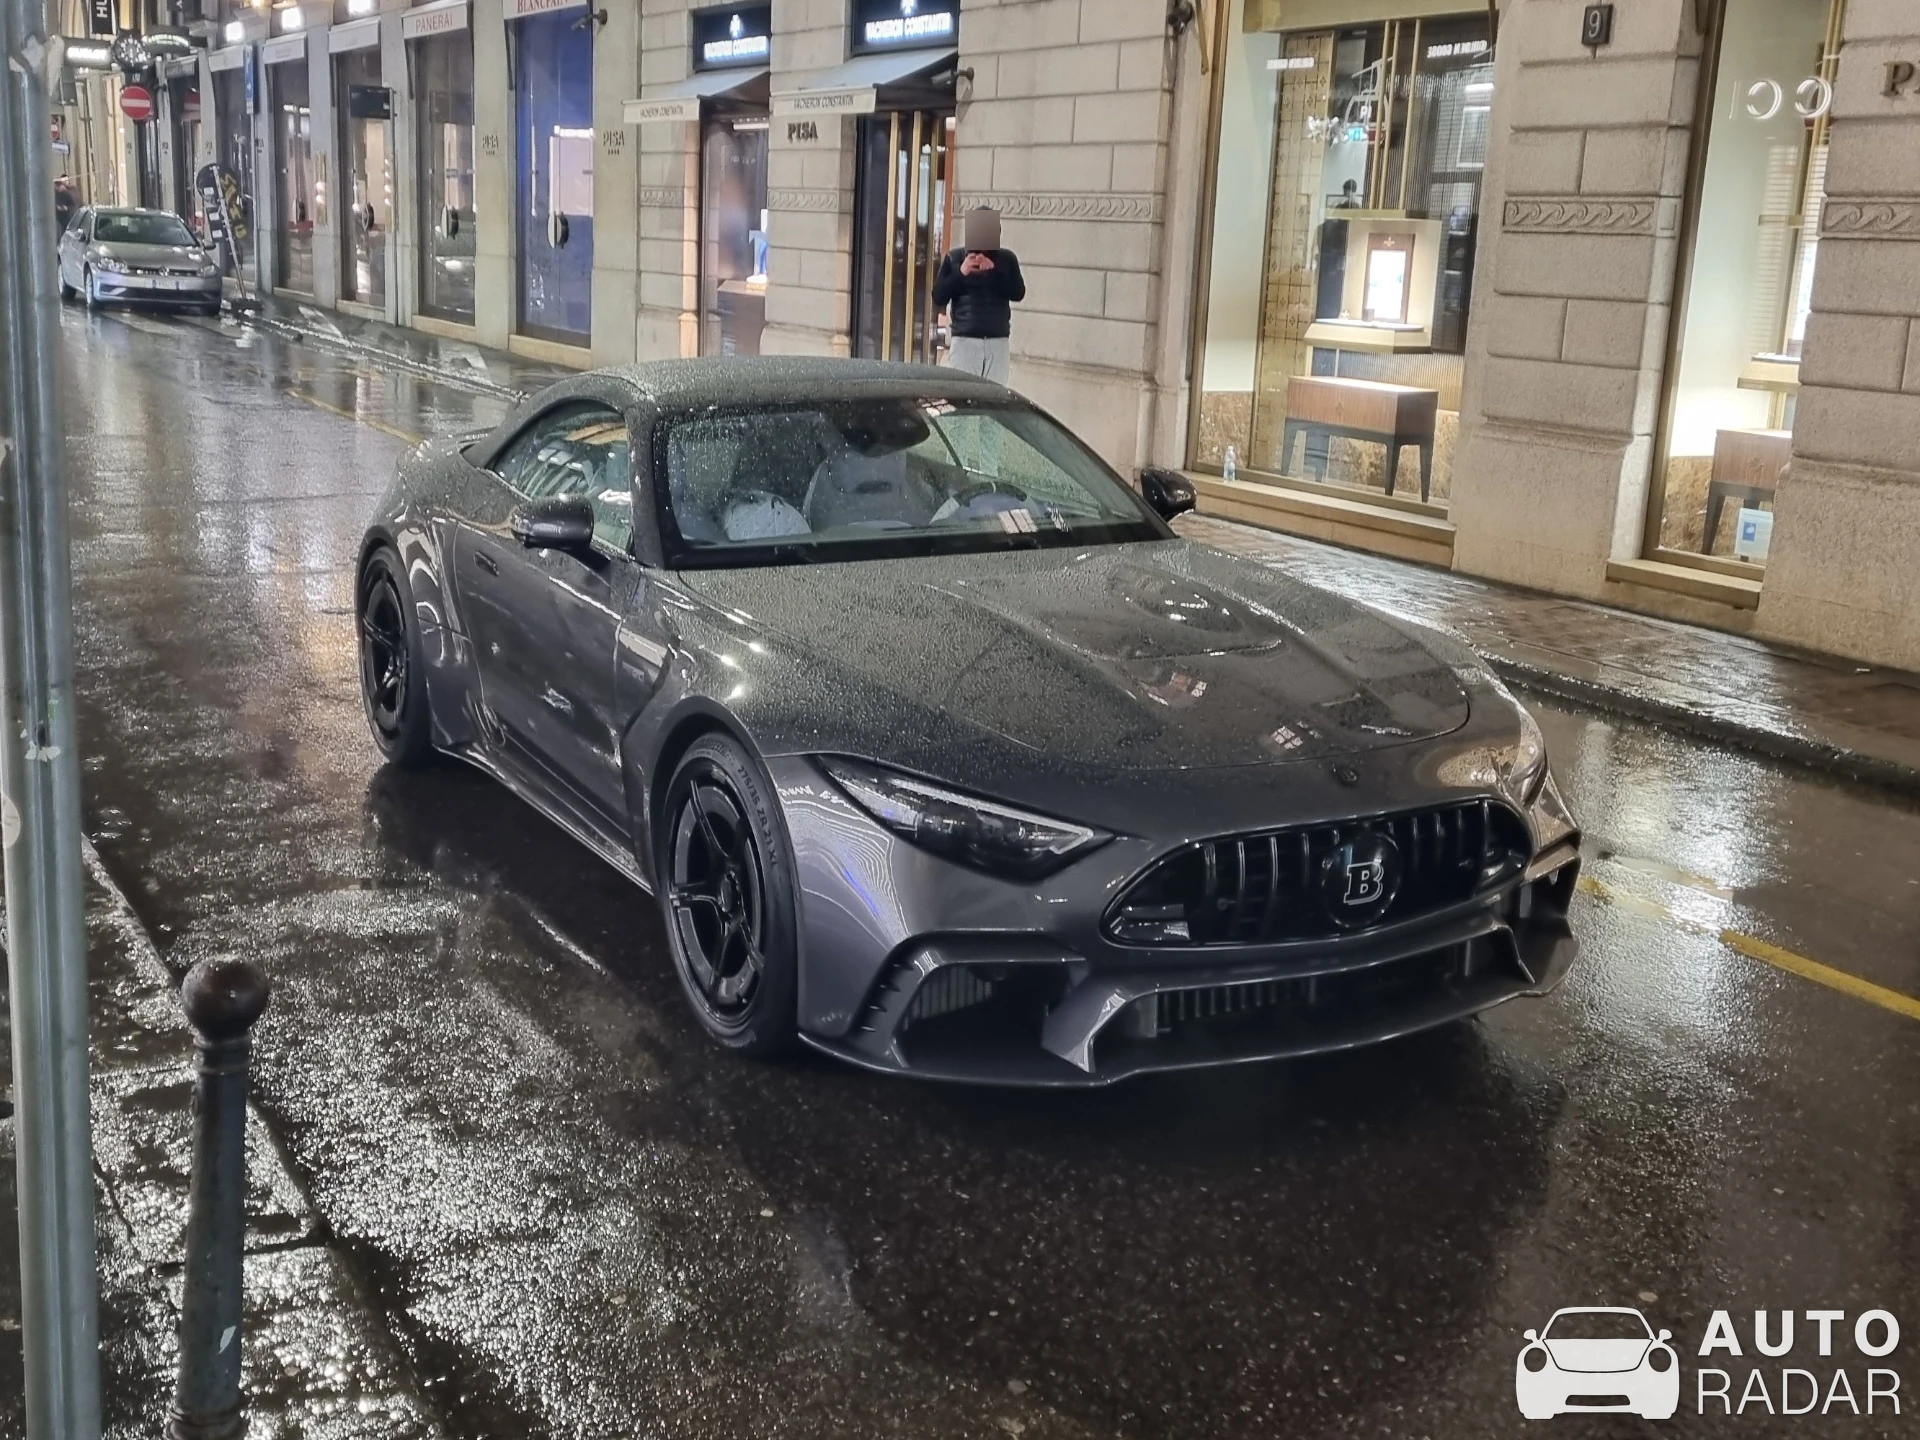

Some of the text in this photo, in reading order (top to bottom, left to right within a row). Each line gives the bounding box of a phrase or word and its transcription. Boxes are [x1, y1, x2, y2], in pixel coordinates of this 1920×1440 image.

[415, 12, 453, 33] PANERAI
[1589, 10, 1600, 37] 9
[603, 130, 625, 147] PISA
[788, 121, 818, 142] PISA
[1343, 861, 1384, 905] B
